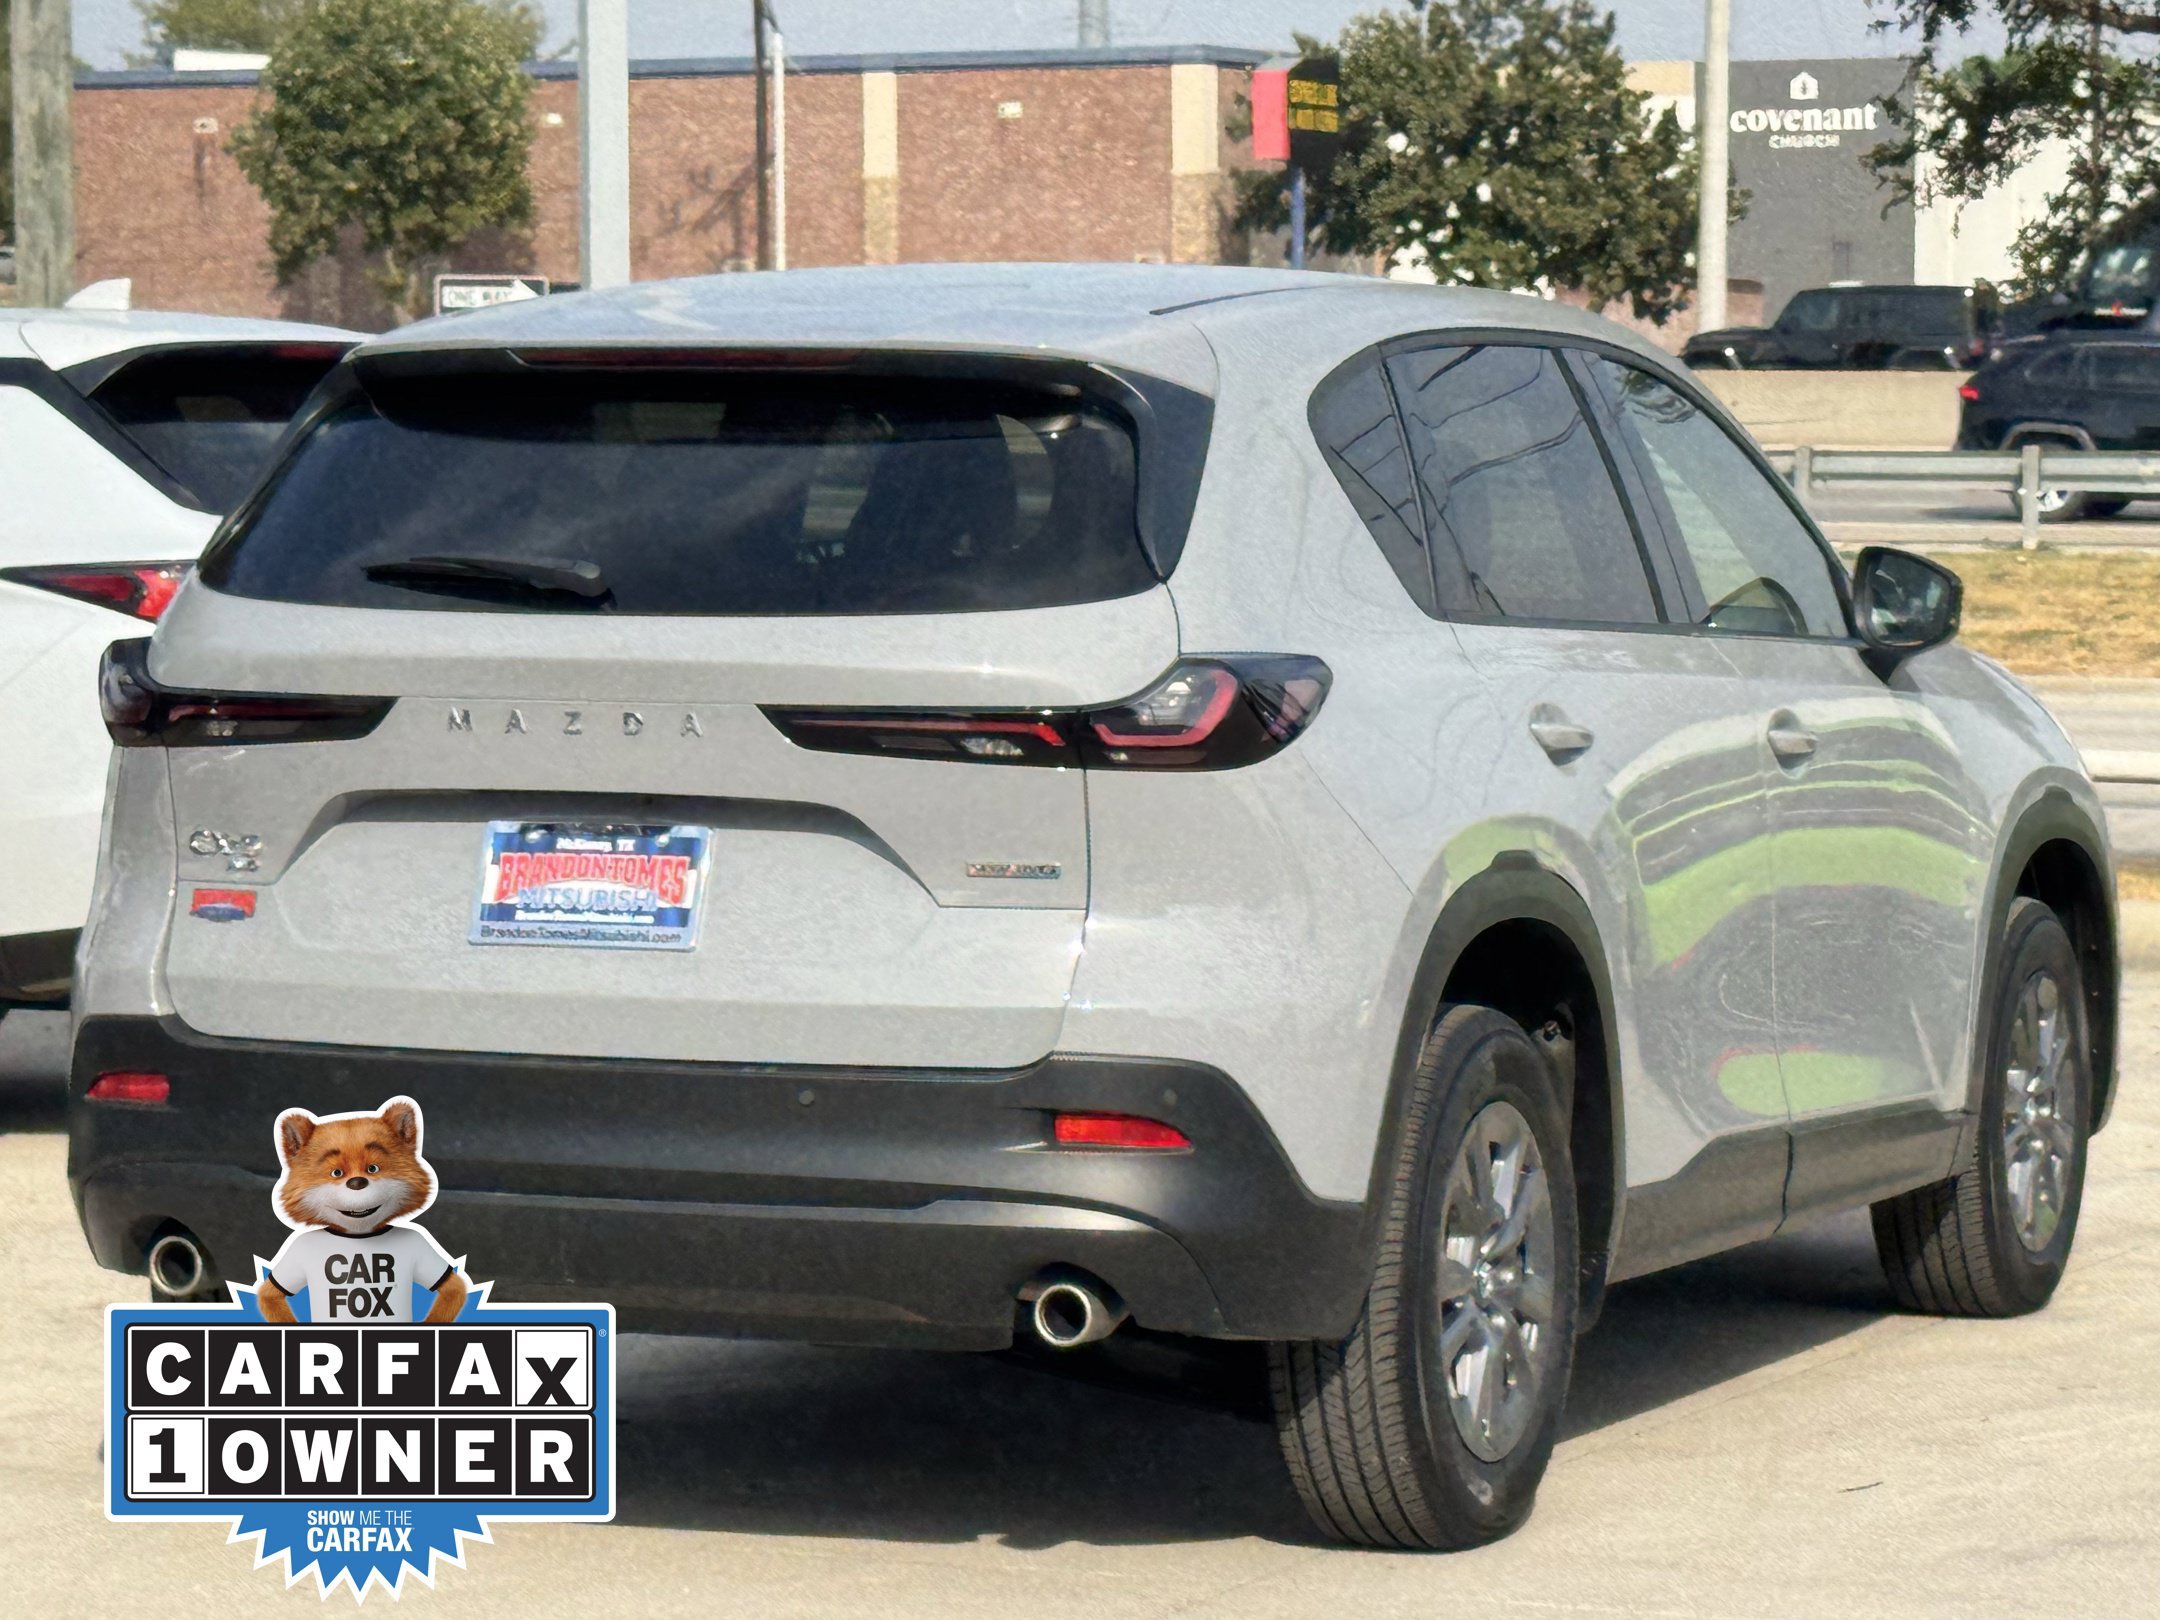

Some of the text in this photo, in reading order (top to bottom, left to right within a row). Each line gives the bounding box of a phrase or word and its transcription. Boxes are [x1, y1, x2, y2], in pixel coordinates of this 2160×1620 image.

[1729, 102, 1879, 133] covenant
[447, 705, 704, 738] MAZDA
[516, 886, 660, 912] MITSUBISHI
